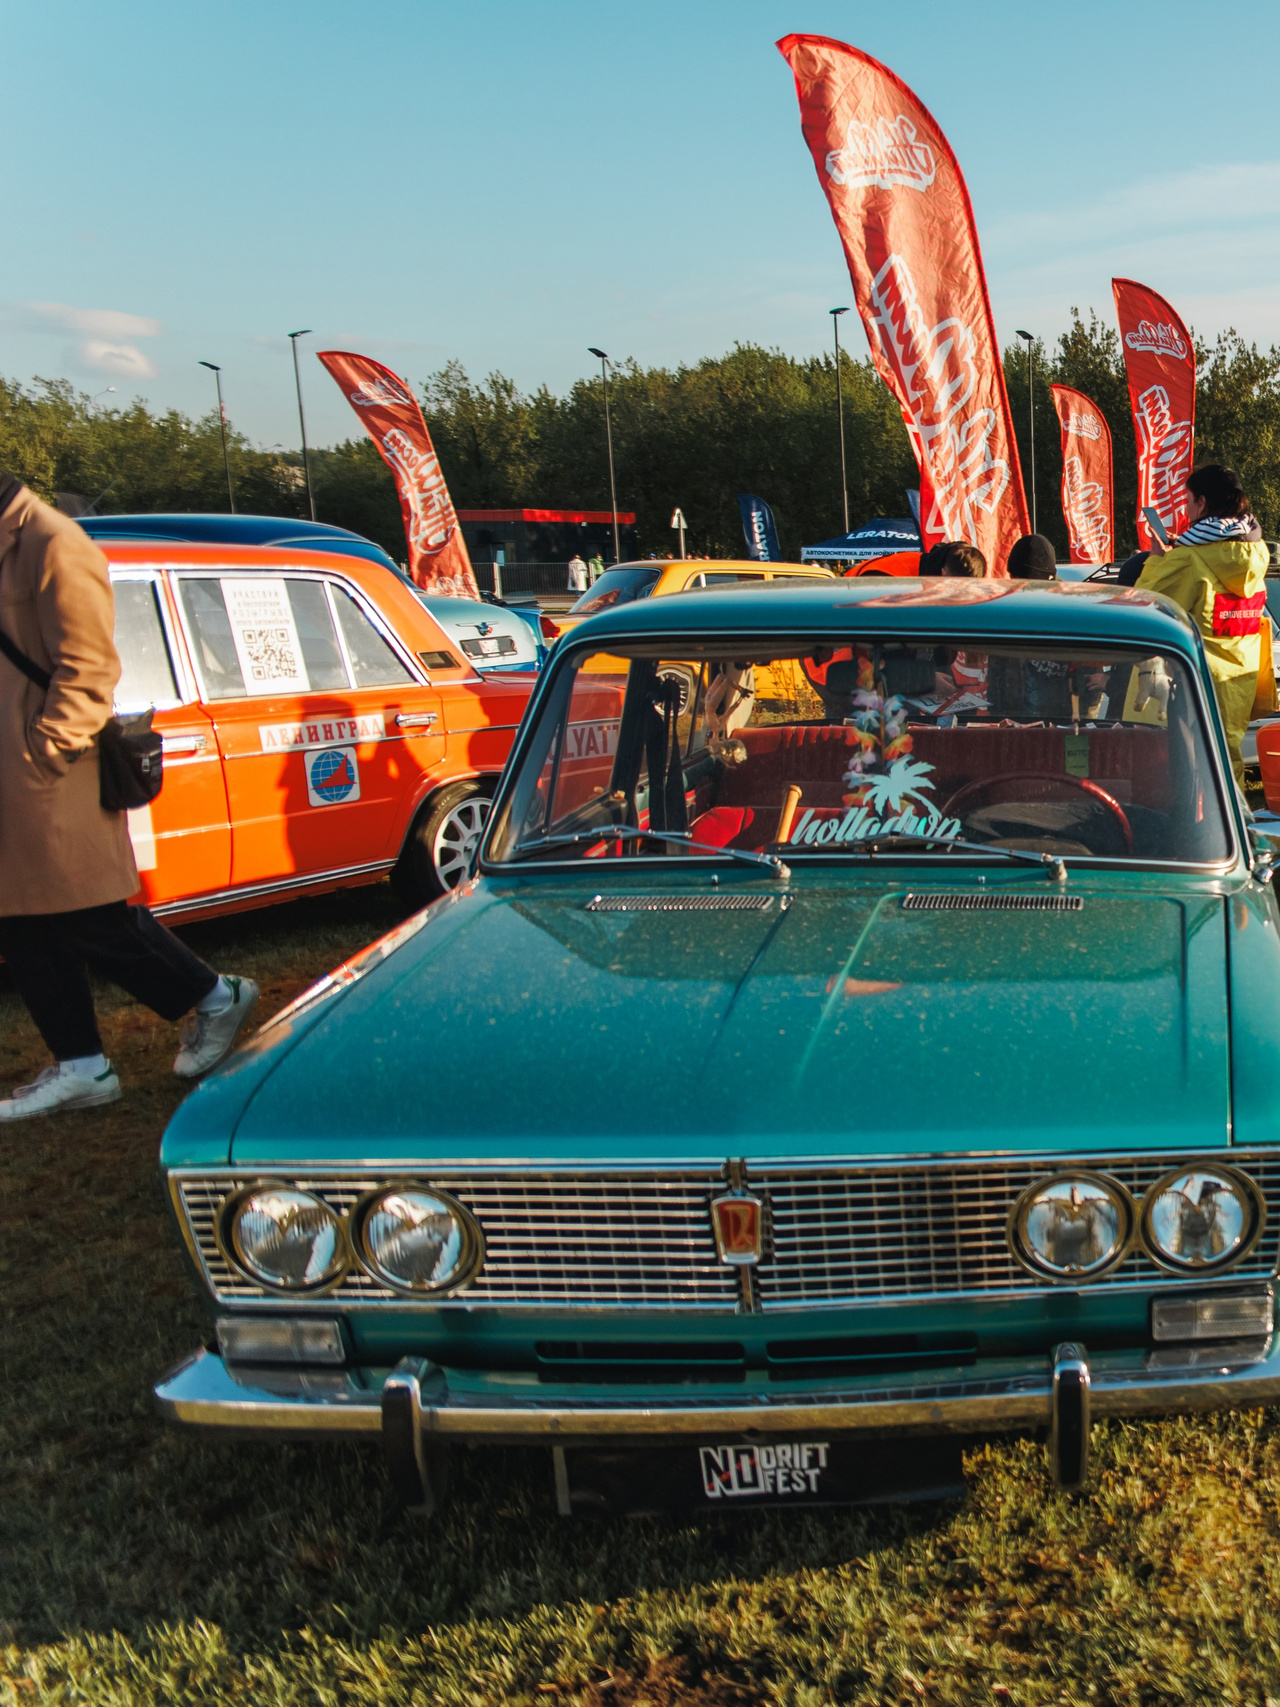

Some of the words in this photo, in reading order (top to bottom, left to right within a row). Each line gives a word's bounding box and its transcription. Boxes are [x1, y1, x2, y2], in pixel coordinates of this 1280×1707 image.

[846, 530, 919, 541] LERATON
[265, 717, 383, 748] ЛЕНИНГРАД
[760, 1442, 831, 1470] DRIFT
[764, 1467, 822, 1495] FEST
